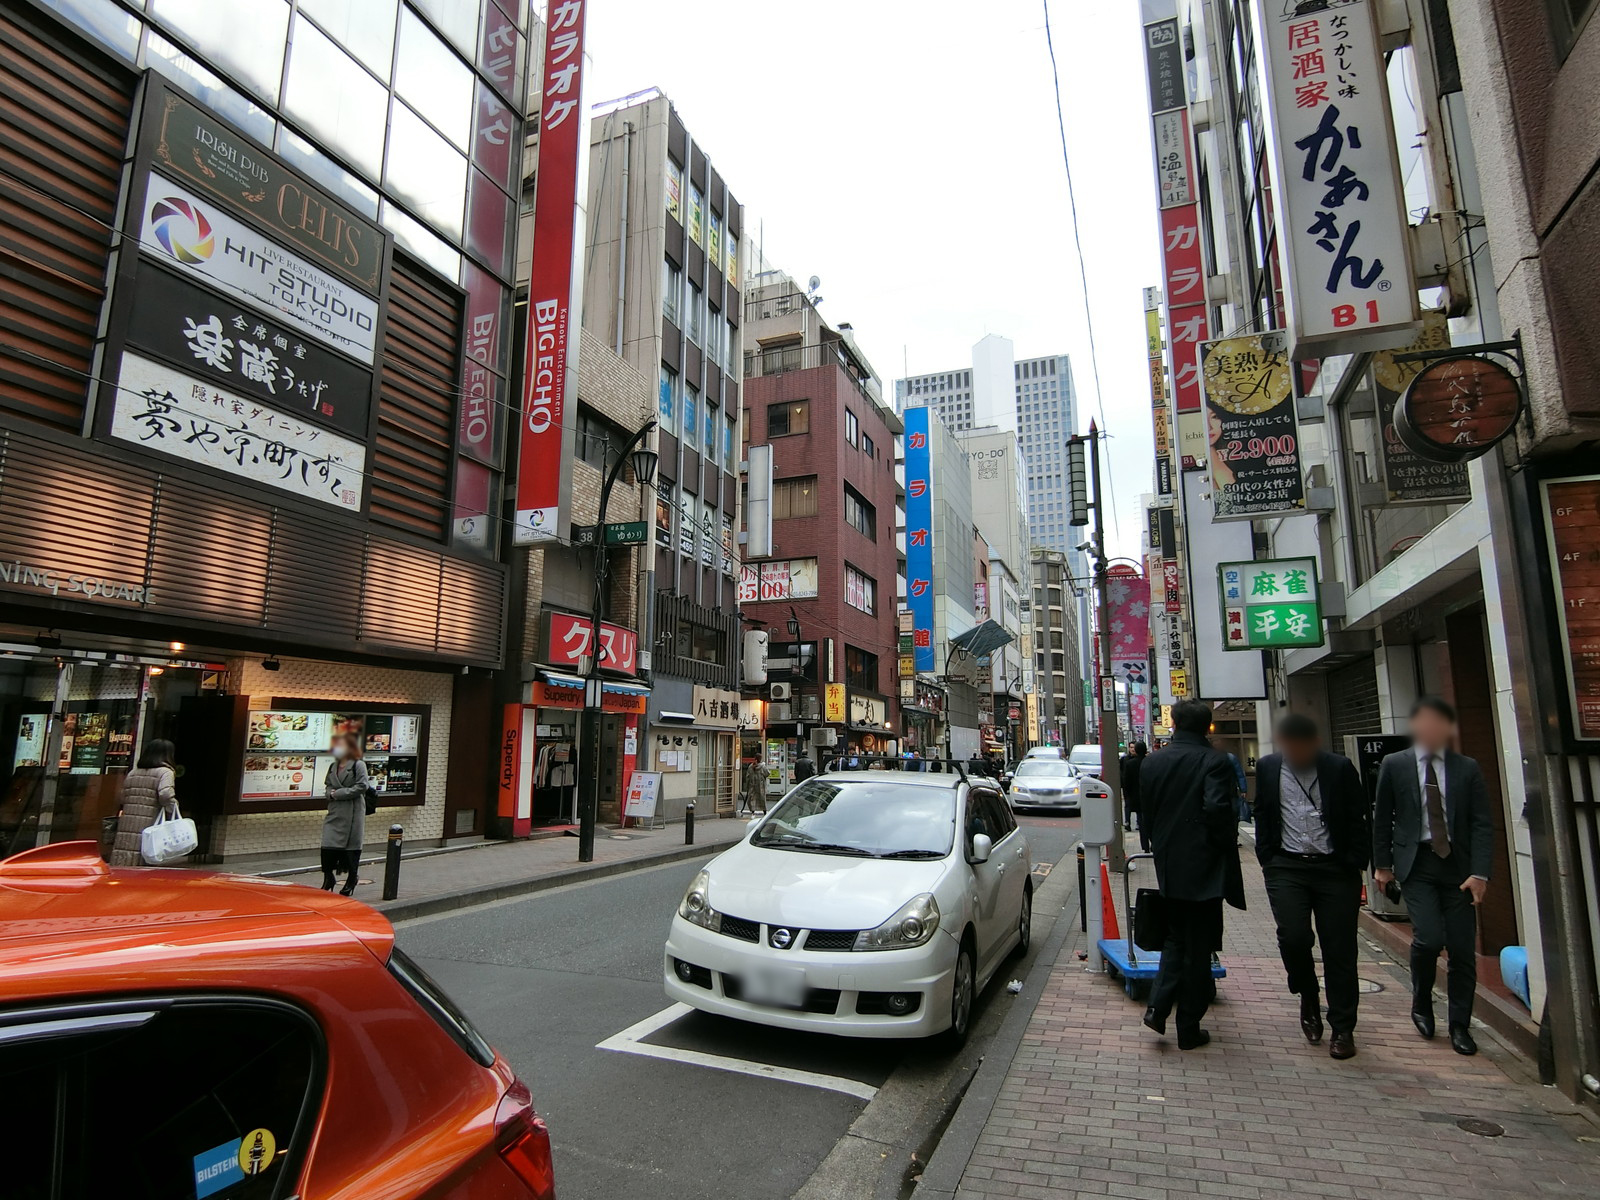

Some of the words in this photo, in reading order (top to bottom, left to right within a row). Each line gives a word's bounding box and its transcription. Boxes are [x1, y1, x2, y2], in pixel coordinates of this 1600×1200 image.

[545, 1, 582, 130] カラオケ
[1289, 20, 1330, 108] 居酒家
[1330, 15, 1359, 99] なつかしい味
[195, 125, 238, 164] IRISH
[240, 155, 269, 183] PUB
[1166, 190, 1185, 203] 4F
[277, 183, 362, 268] CELTS
[224, 237, 274, 275] HIT
[278, 267, 373, 332] STUDIO
[263, 246, 285, 265] LIVE
[286, 260, 344, 297] RESTAURANT
[269, 282, 332, 324] TOKYO
[1166, 225, 1205, 389] カラオケ
[1331, 300, 1380, 327] B1
[231, 314, 308, 361] 全席個室
[535, 299, 559, 353] BIG
[559, 308, 568, 345] Karaoke
[1266, 336, 1284, 348] 7F
[1212, 350, 1282, 378] 美熟女
[1225, 373, 1256, 385] エース
[528, 355, 554, 434] ECHO
[555, 348, 566, 417] Entertainment
[192, 383, 322, 442] 隠れ家ダイニング
[1221, 415, 1291, 431] 何時に入店しても
[132, 388, 343, 498] 夢や京町しずく
[1223, 429, 1257, 440] ご延長も
[969, 449, 1004, 460] YO-DO
[1224, 478, 1296, 494] 30代の女性が
[1233, 489, 1289, 503] 中心のお店
[1556, 507, 1573, 516] 6F
[580, 532, 593, 543] 38
[617, 530, 643, 541] ゆかり
[909, 432, 930, 648] カラオケ館
[1563, 552, 1581, 562] 4F
[67, 574, 157, 605] SQUARE
[1164, 564, 1179, 602] やき肉
[1225, 571, 1240, 599] 空卓
[1251, 569, 1309, 596] 麻雀
[1569, 598, 1586, 608] 1F
[1254, 608, 1312, 640] 平安
[563, 621, 635, 669] クスリ
[698, 698, 740, 721] 八吉酒場
[827, 686, 840, 715] 弁当
[500, 729, 517, 790] Superdry
[1363, 741, 1384, 753] 4F
[197, 1155, 239, 1184] BILSTEIN
